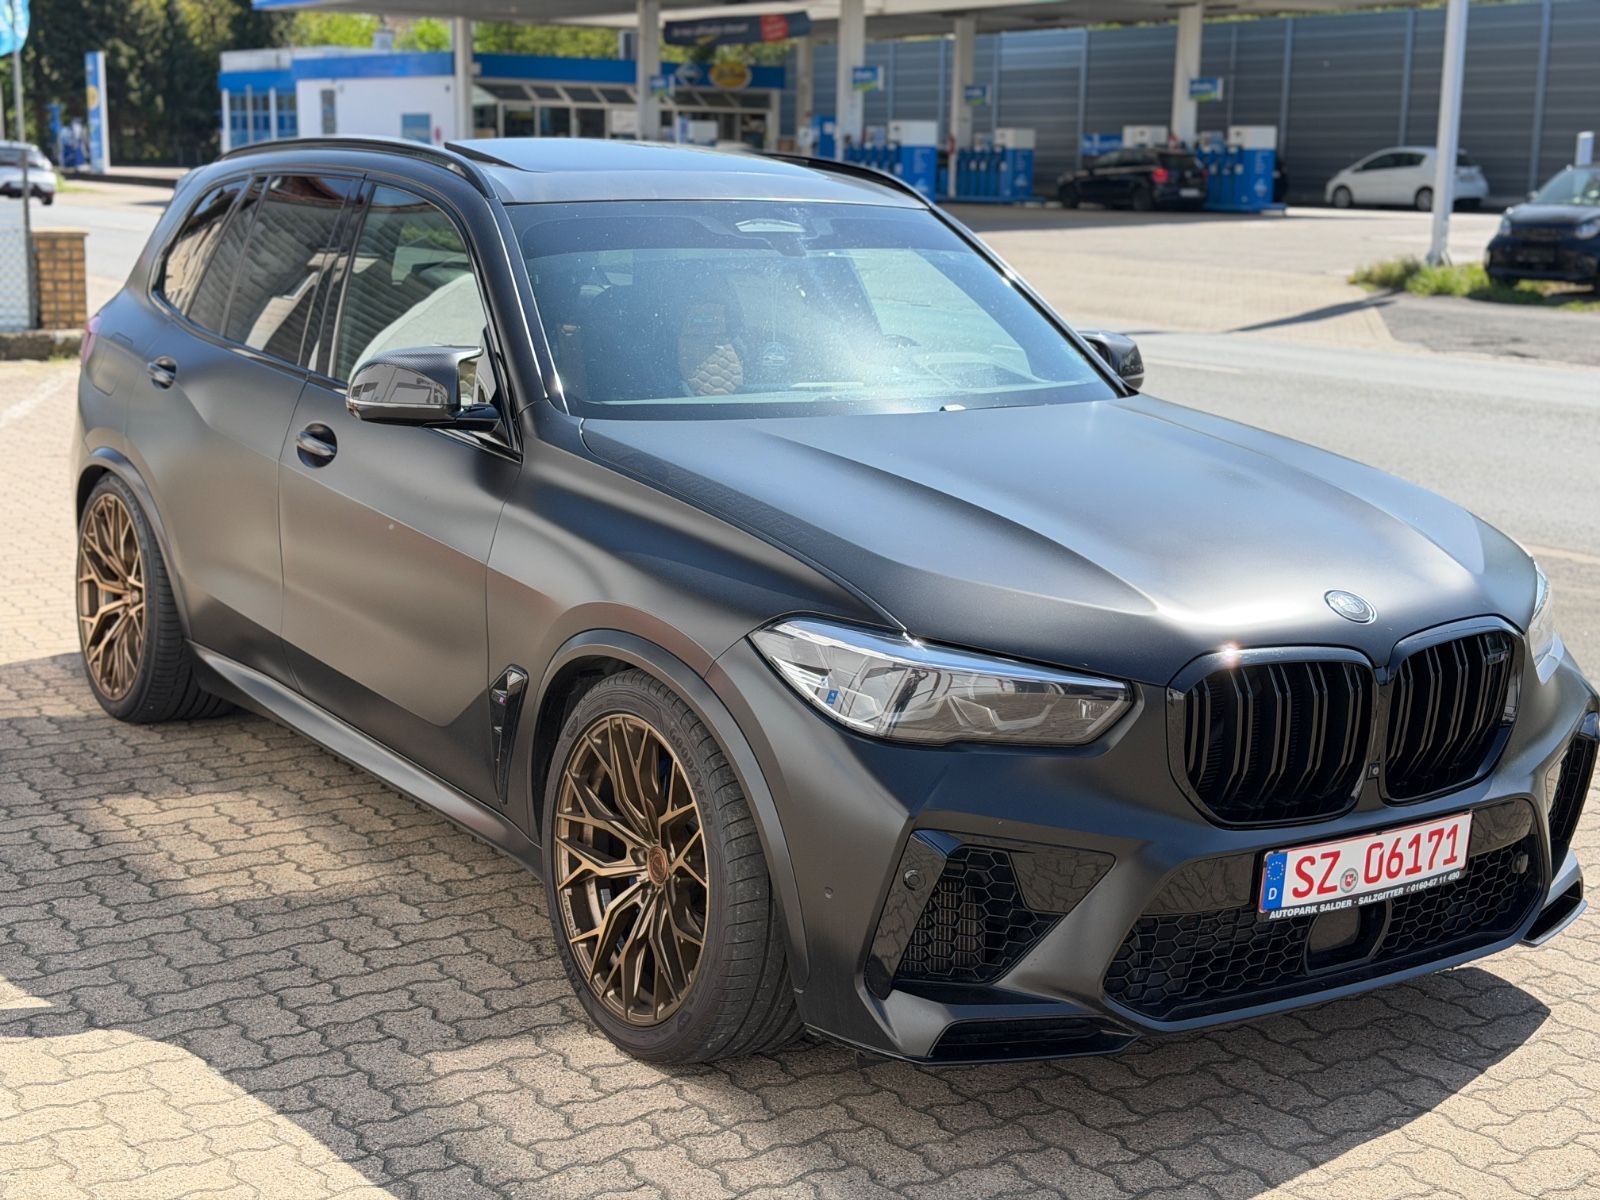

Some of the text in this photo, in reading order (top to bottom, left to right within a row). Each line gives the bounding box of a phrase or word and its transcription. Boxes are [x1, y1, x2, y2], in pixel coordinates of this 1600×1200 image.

[1292, 823, 1459, 899] SZ 06171
[1268, 887, 1278, 901] D
[1269, 905, 1318, 920] AUTOPARK
[1319, 900, 1352, 913] SALDER
[1358, 887, 1404, 905] SALZGITTER
